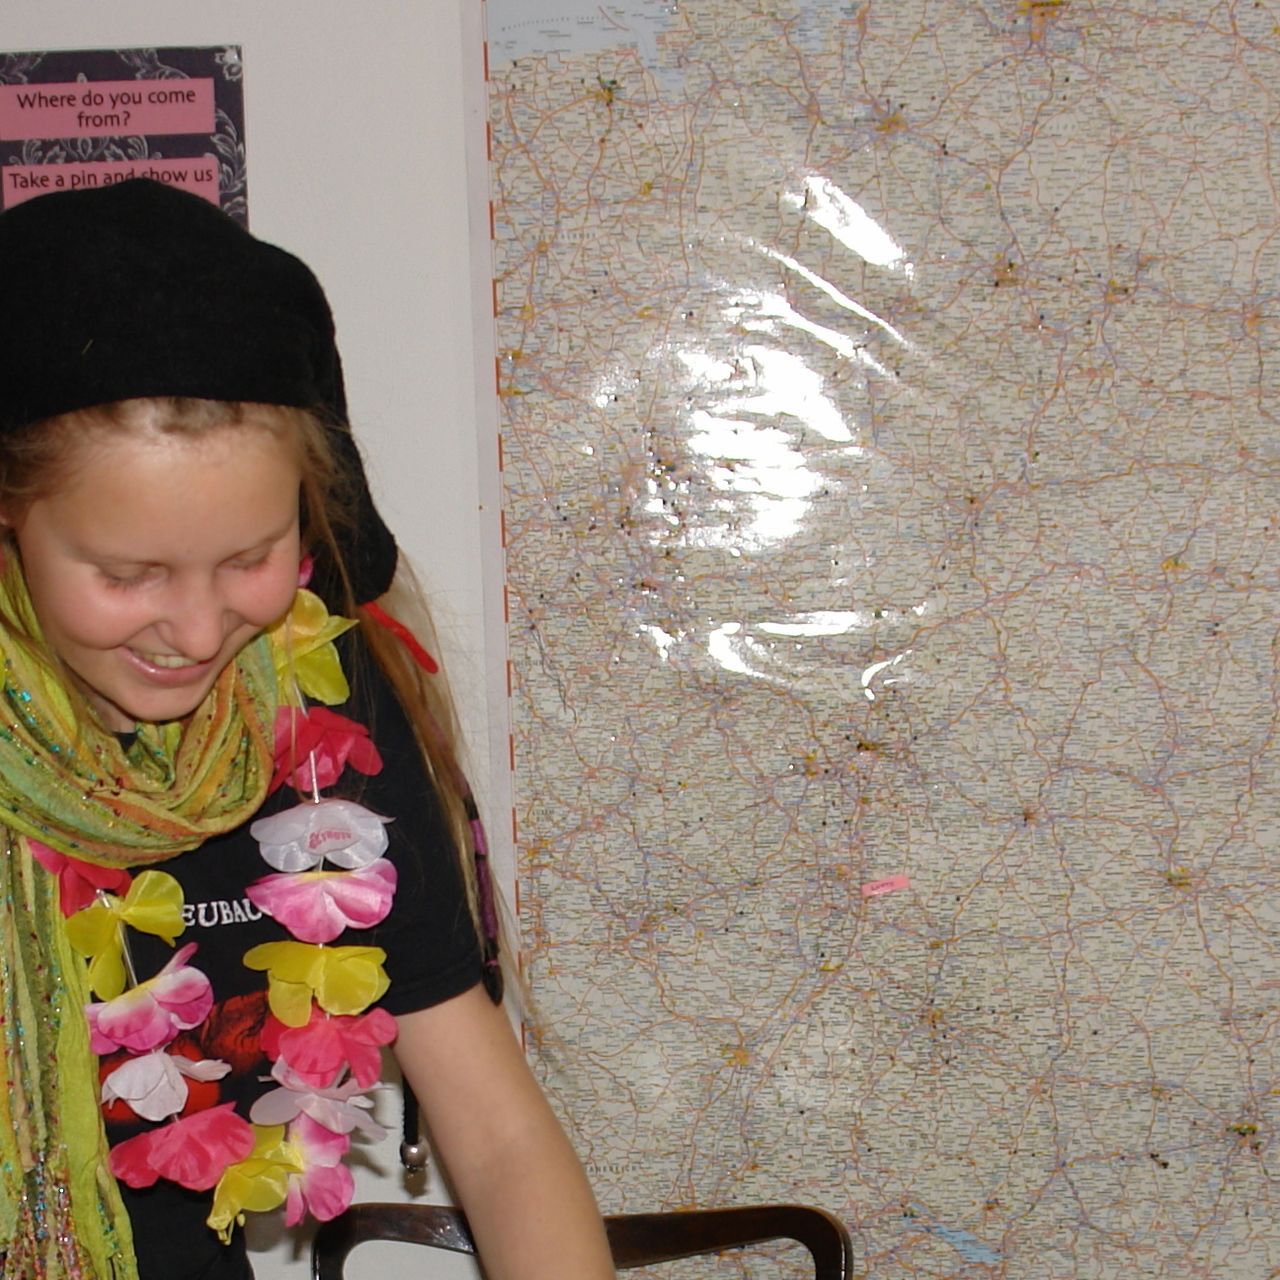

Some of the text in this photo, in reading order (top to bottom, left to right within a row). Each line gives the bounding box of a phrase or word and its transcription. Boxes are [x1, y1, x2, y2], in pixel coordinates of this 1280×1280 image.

[16, 89, 196, 109] Where do you come
[77, 112, 131, 129] from?
[8, 172, 50, 189] Take
[55, 176, 65, 188] a
[70, 170, 98, 189] pin
[194, 168, 213, 183] us
